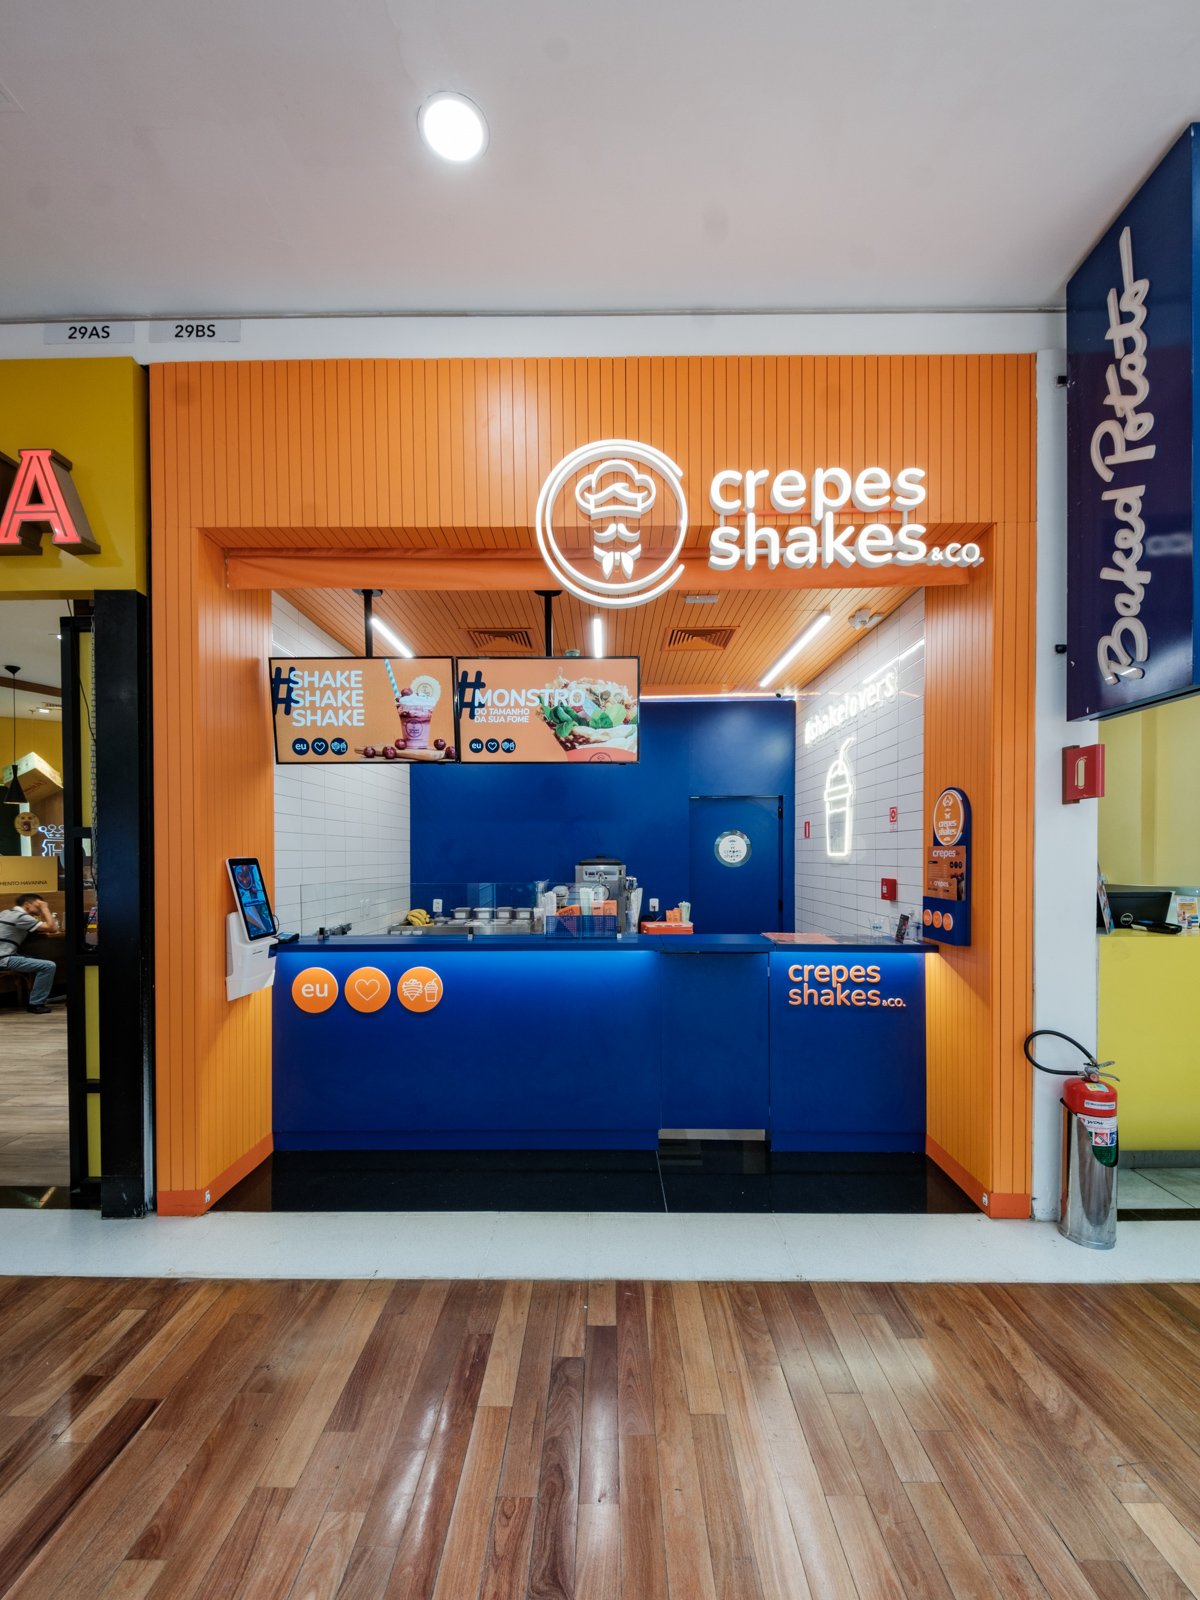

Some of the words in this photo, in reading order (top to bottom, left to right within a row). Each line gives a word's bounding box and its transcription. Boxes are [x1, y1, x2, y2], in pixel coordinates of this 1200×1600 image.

[68, 325, 110, 339] 29AS
[174, 323, 216, 338] 29BS
[709, 466, 927, 526] crepes
[708, 510, 928, 570] shakes
[1097, 484, 1152, 686] Baked
[290, 690, 364, 707] SHAKE
[291, 709, 365, 727] SHAKE
[474, 708, 487, 716] DO
[489, 708, 530, 716] TAMANHO
[474, 715, 486, 723] DA
[488, 715, 505, 723] SUA
[507, 715, 529, 723] FOME
[471, 741, 482, 749] eu
[788, 964, 881, 988] crepes
[301, 983, 328, 998] eu
[788, 983, 881, 1006] shakes
